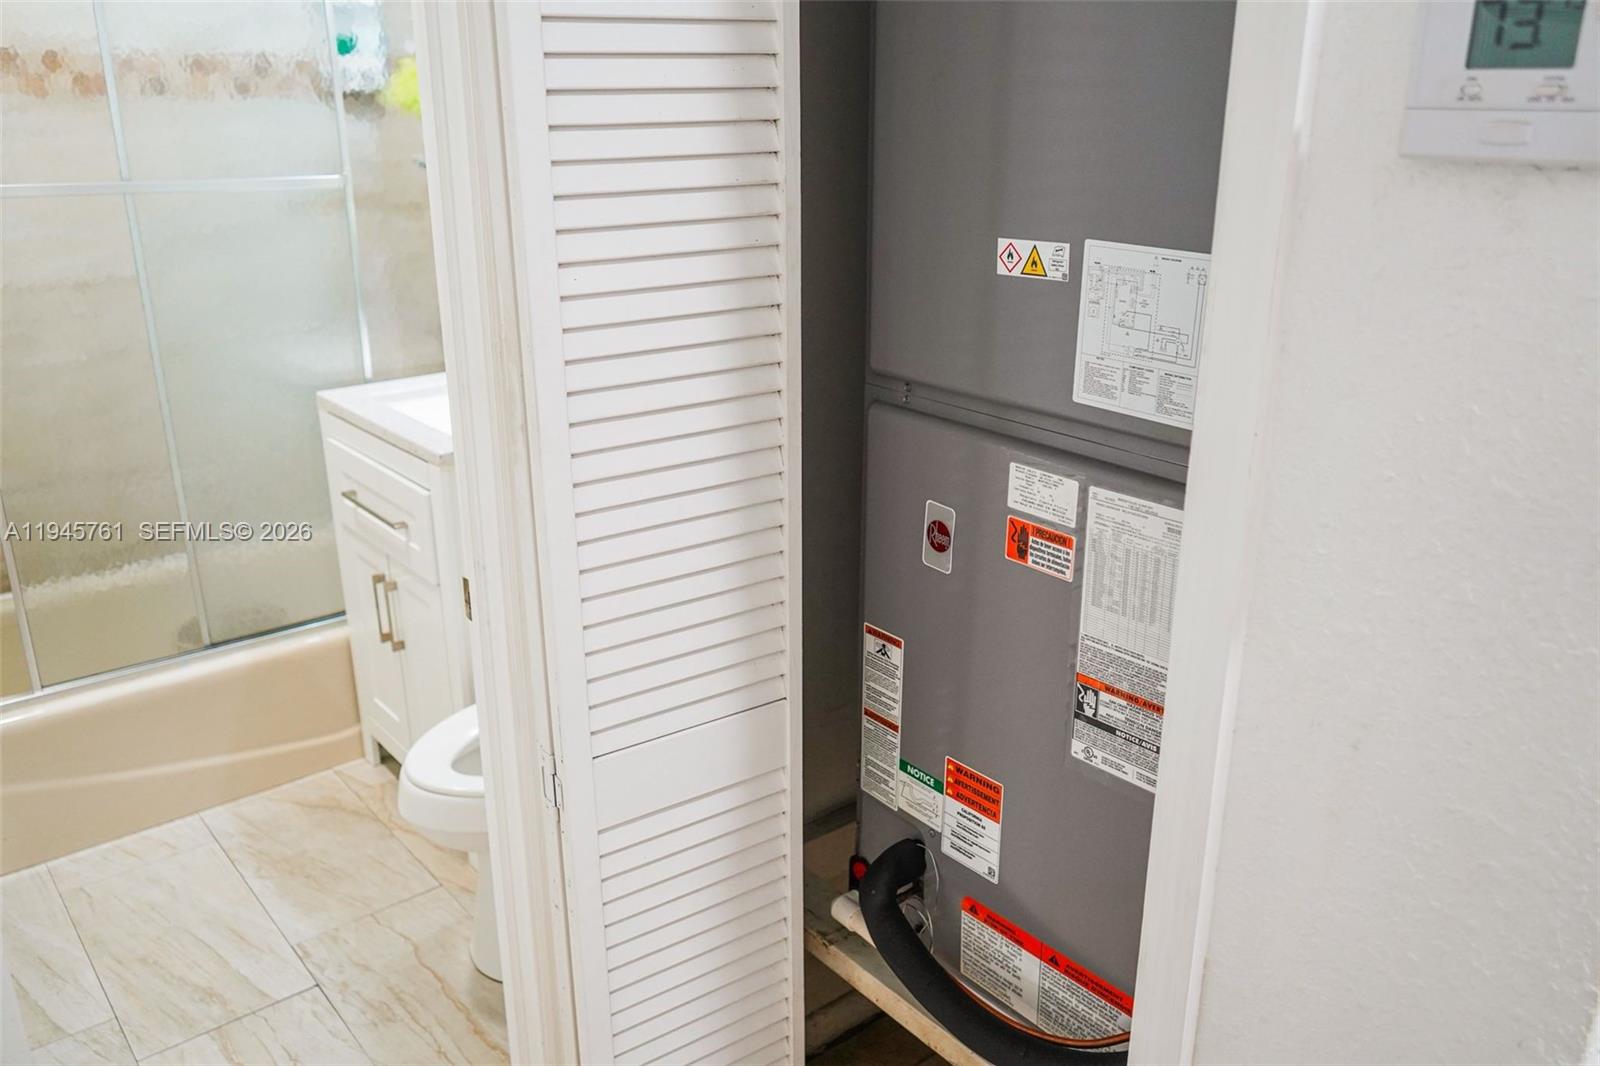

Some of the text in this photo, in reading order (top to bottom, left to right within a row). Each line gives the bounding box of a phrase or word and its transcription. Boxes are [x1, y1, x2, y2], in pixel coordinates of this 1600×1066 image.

[929, 520, 950, 548] Rheem
[907, 765, 935, 787] NOTICE
[955, 765, 1000, 794] WARNING
[956, 791, 997, 819] ADVERTENCIA
